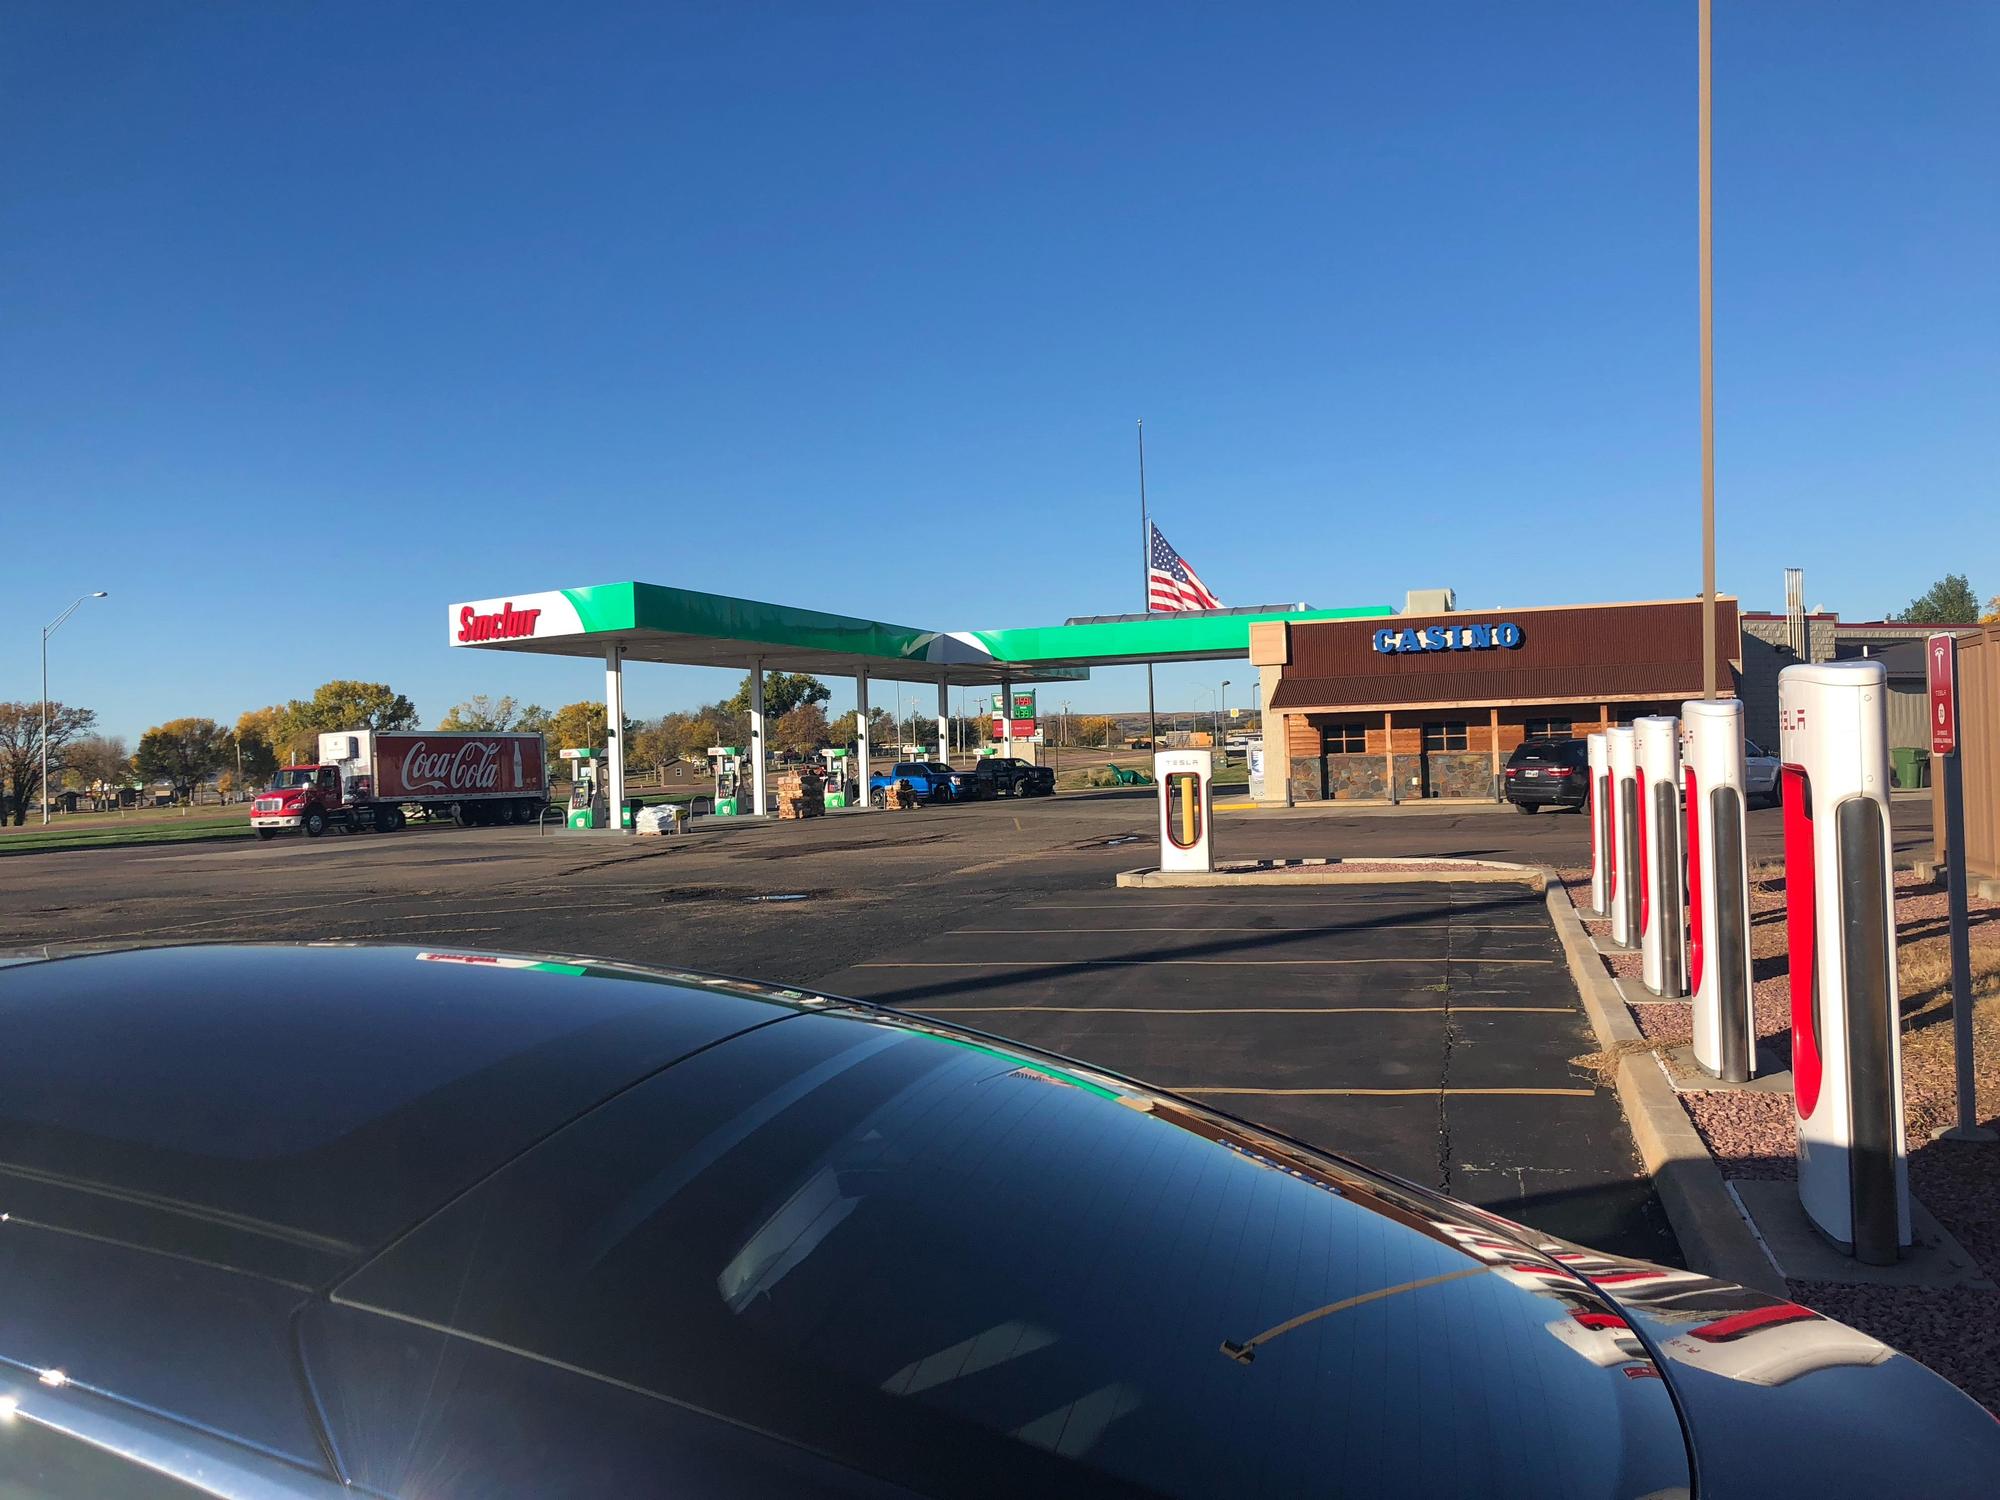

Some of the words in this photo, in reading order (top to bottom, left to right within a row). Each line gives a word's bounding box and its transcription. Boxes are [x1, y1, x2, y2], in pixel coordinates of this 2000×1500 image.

[458, 602, 541, 642] Sinclair
[1374, 622, 1520, 653] CASINO
[402, 741, 500, 790] Coca-Cola
